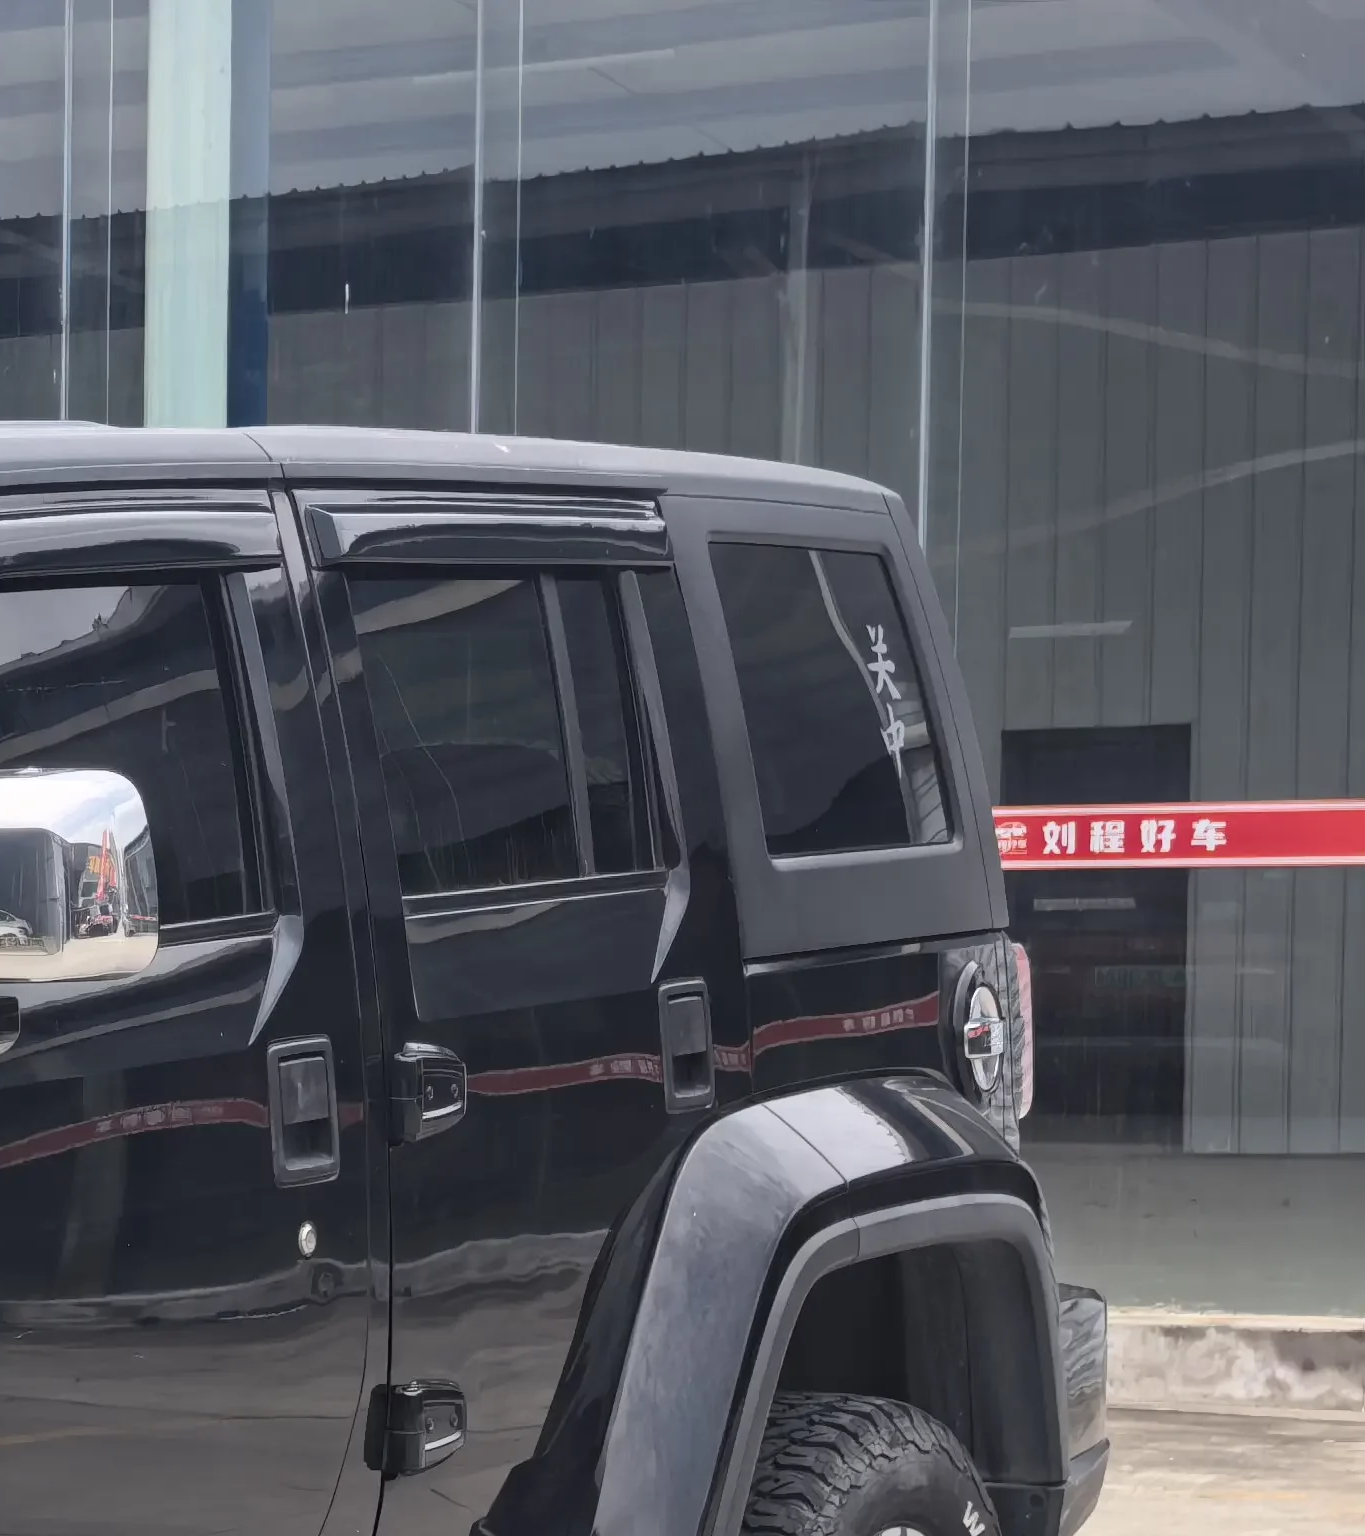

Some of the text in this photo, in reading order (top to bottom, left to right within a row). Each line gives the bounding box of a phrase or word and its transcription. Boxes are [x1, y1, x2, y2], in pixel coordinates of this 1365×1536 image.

[865, 623, 905, 780] 关中
[1041, 818, 1228, 855] 刘程好车
